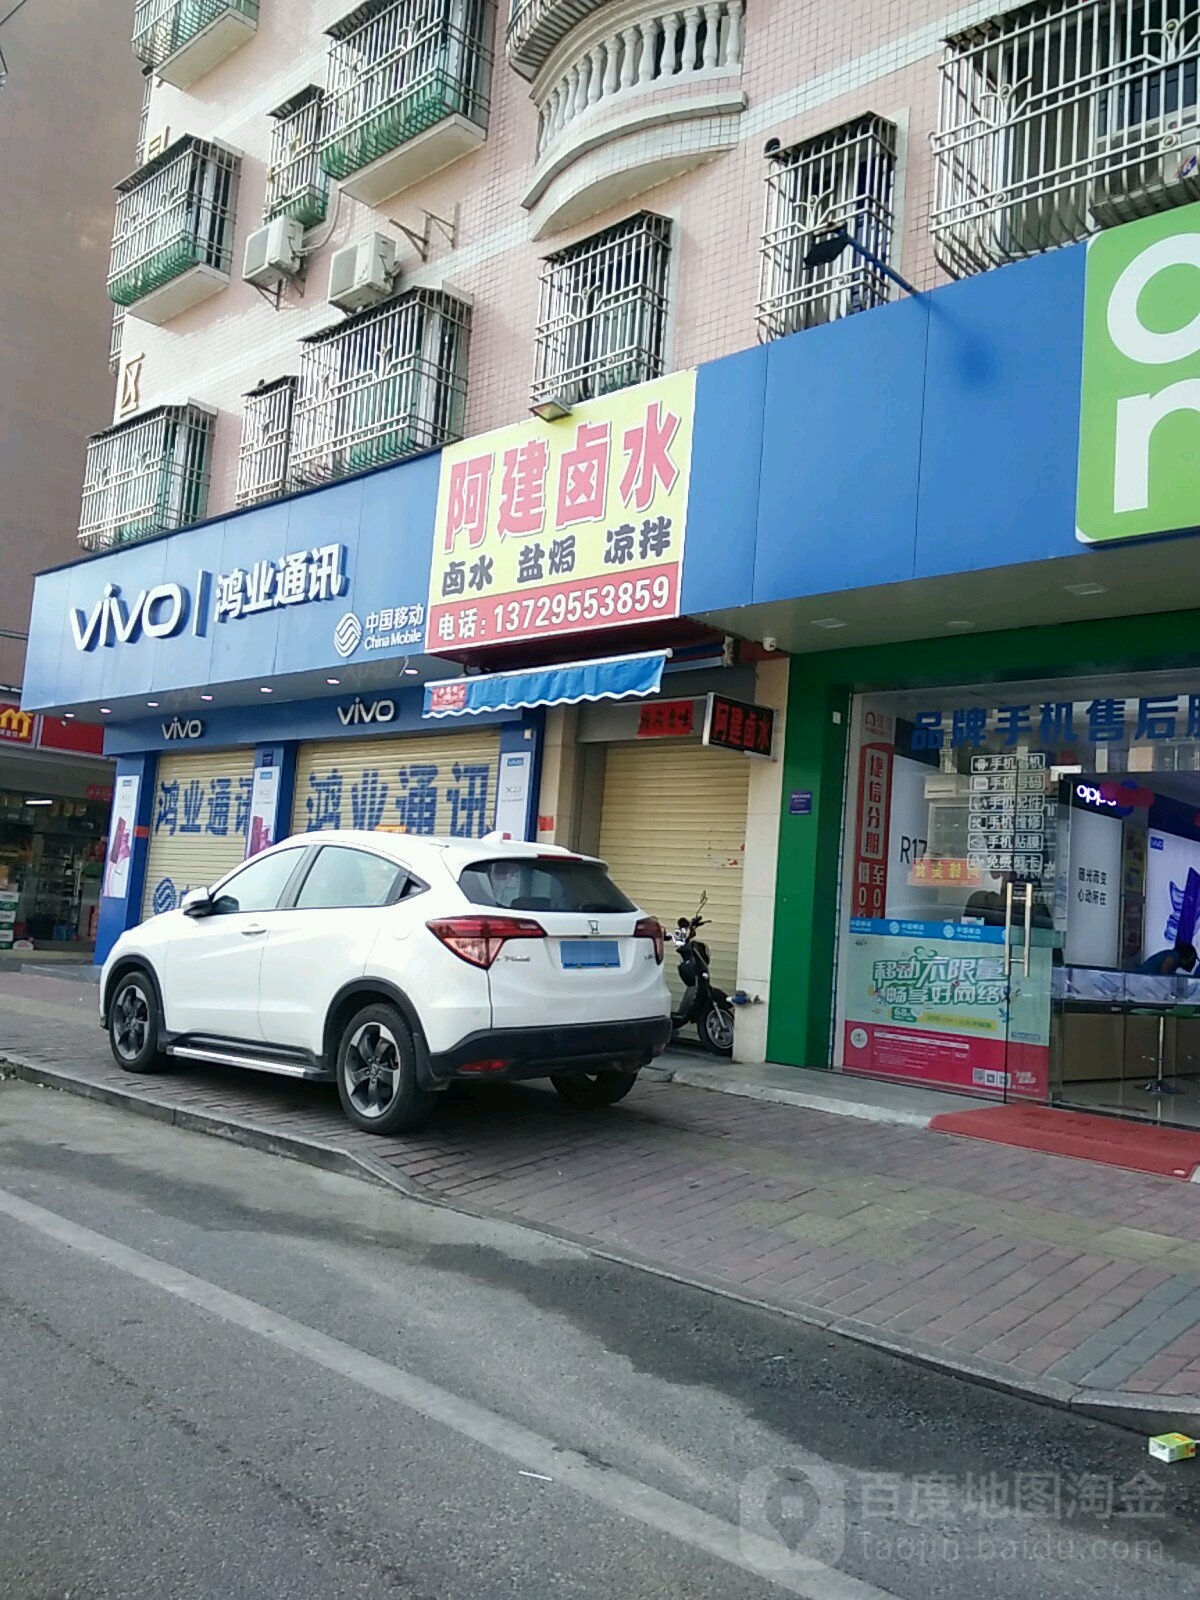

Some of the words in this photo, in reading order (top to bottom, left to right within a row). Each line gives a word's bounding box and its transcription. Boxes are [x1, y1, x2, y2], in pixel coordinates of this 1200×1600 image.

[443, 402, 681, 553] 阿建卤水
[442, 555, 494, 596] 卤水
[517, 535, 576, 583] 盐焗
[604, 517, 671, 565] 凉拌
[70, 582, 186, 651] vivo
[213, 544, 349, 623] 鸿业通讯
[493, 576, 669, 633] 13729553859
[365, 604, 424, 633] 中国移动
[364, 634, 390, 650] China
[390, 630, 422, 647] Mobile
[337, 697, 396, 726] vivo
[161, 716, 203, 740] vivo
[988, 795, 1042, 810] 手机配件
[987, 815, 1041, 830] 手机维修
[987, 835, 1040, 849] 手机贴膜
[873, 957, 1007, 988] 移动不限量
[884, 984, 1002, 1005] 畅享好网络
